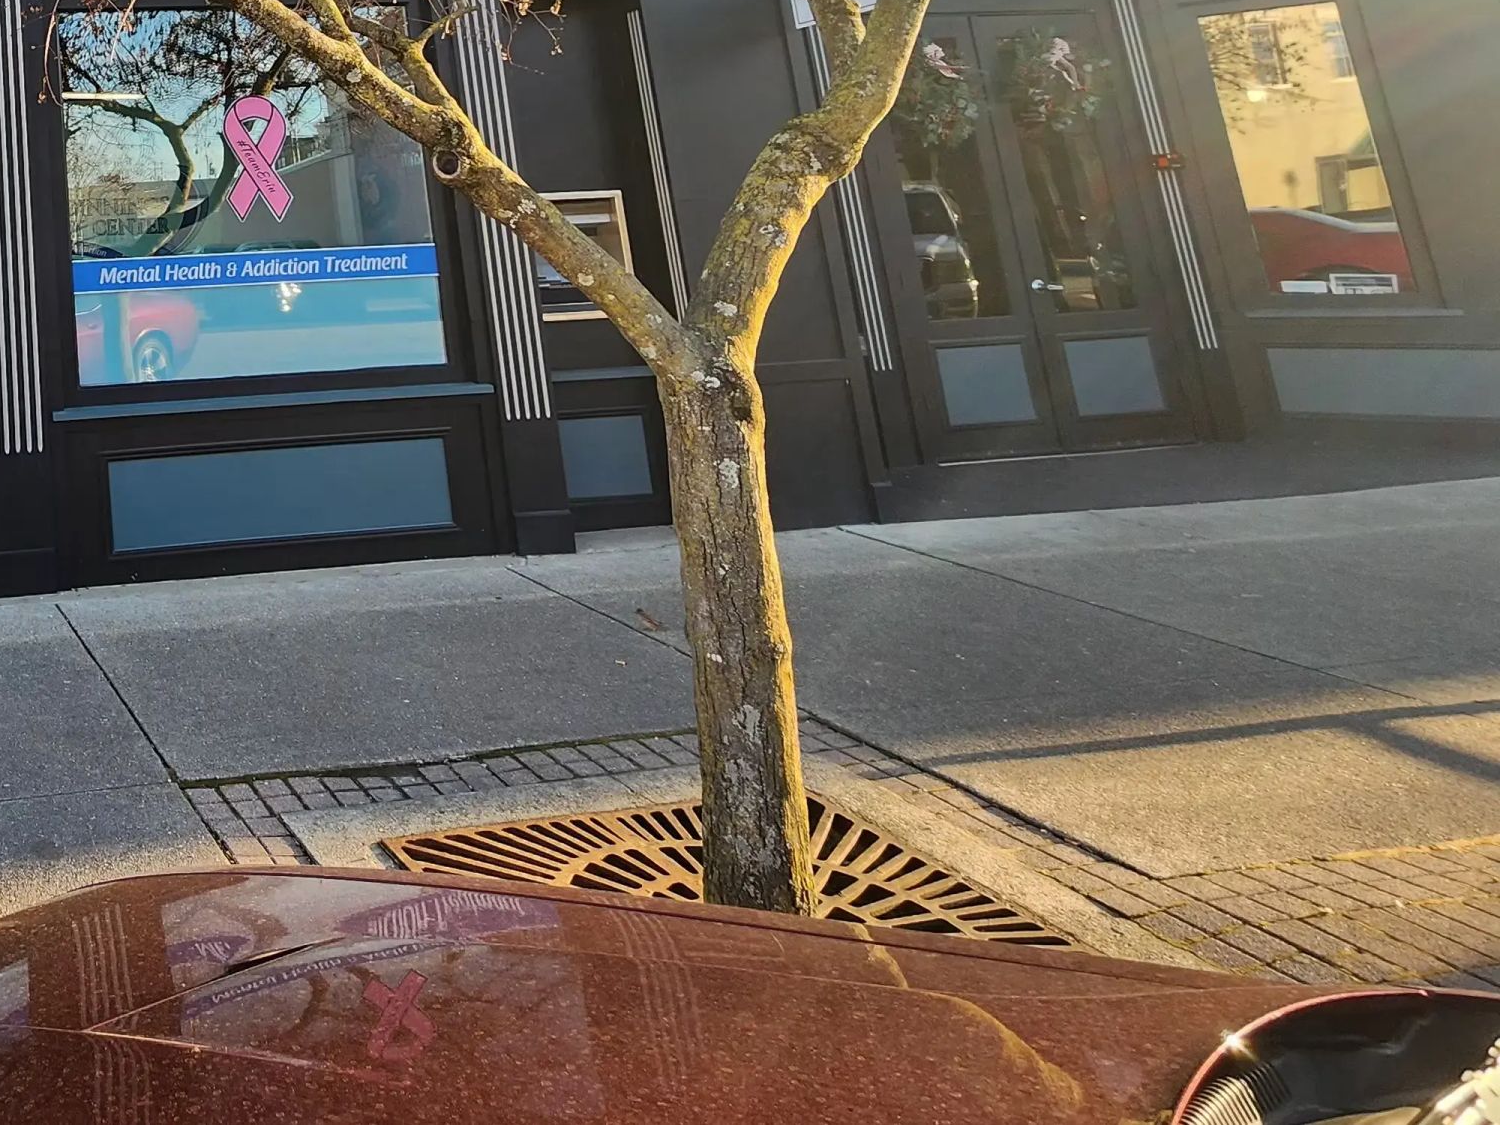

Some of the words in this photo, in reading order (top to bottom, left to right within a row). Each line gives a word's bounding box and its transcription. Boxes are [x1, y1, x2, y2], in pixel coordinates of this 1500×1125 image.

[236, 140, 276, 193] #TeamErin
[99, 264, 161, 285] Mental
[165, 261, 221, 282] Health
[225, 263, 237, 277] &
[241, 257, 320, 277] Addiction
[323, 253, 408, 273] Treatment
